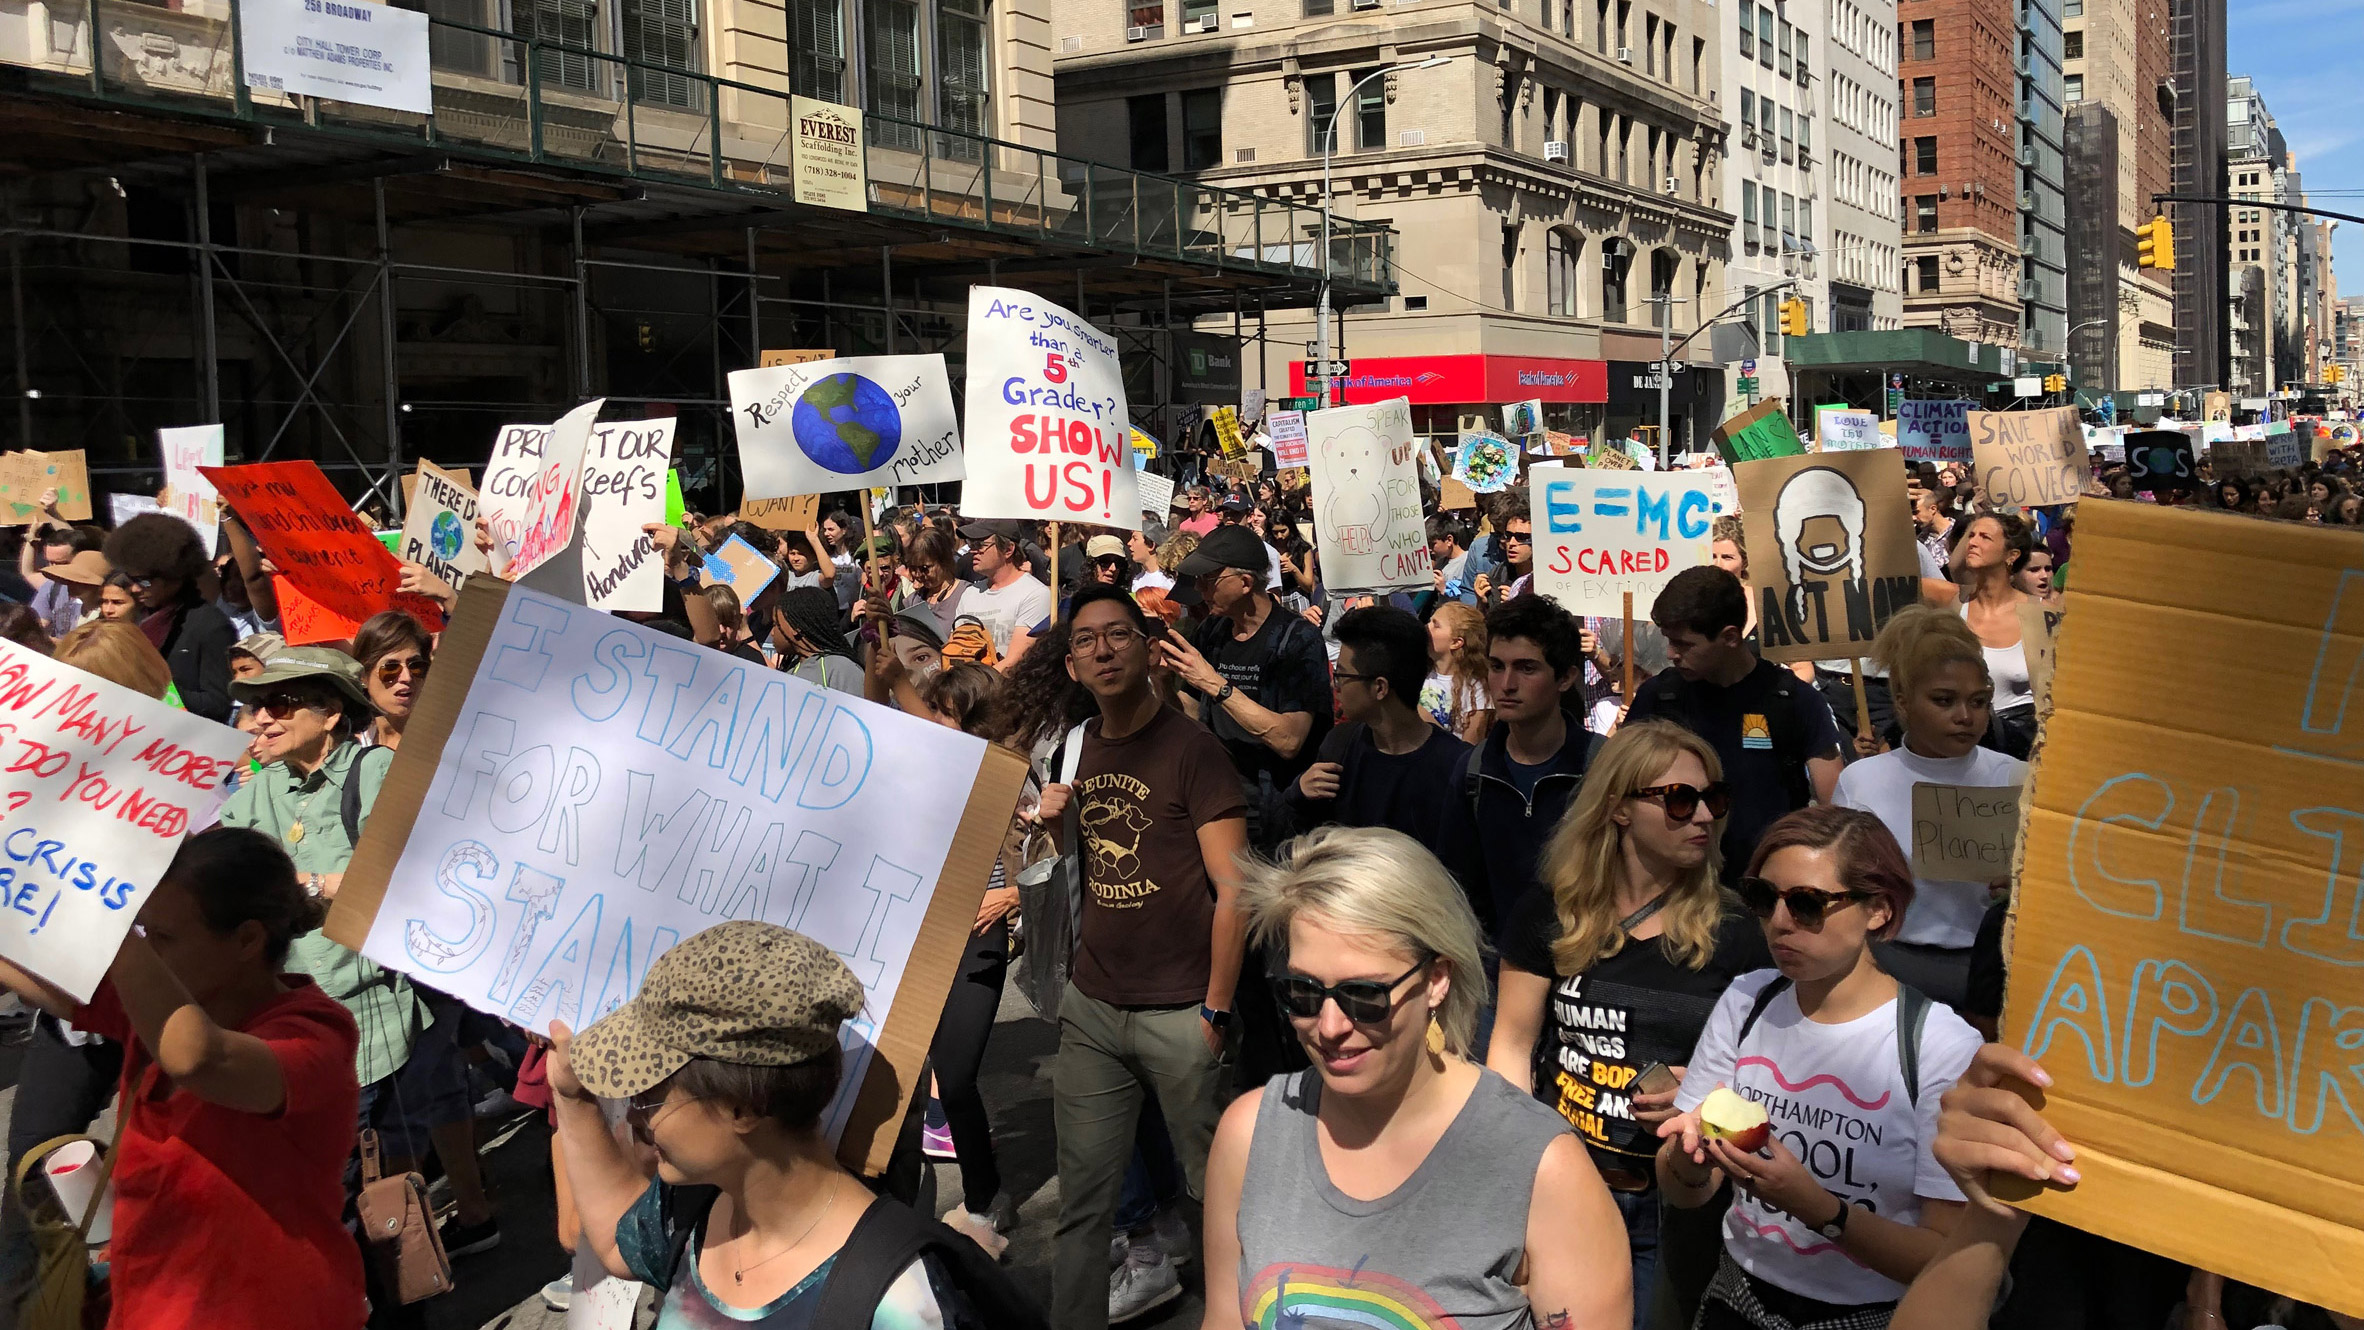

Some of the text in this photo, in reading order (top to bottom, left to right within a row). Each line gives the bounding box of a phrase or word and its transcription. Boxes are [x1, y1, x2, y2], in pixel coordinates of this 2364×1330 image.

[305, 0, 372, 22] 258 BROADWAY
[296, 36, 313, 47] CITY
[316, 39, 334, 52] HALL
[336, 43, 360, 56] TOWER
[297, 47, 325, 61] MATTHEW
[327, 51, 347, 64] ADAMS
[348, 55, 382, 70] PROPERTIES
[800, 118, 857, 144] EVEREST
[801, 139, 843, 157] Scaffolding
[845, 147, 858, 157] Inc.
[804, 165, 857, 180] (718) 328-1004
[984, 299, 1035, 321] Are
[1040, 311, 1072, 332] you
[1029, 330, 1086, 363] than a
[1208, 354, 1232, 368] Bank
[893, 375, 922, 408] your
[1355, 377, 1367, 388] of
[1368, 375, 1412, 387] America
[1540, 370, 1565, 387] America
[1633, 376, 1644, 389] DE
[743, 367, 809, 429] Respect
[1002, 376, 1117, 427] Grader?
[1899, 402, 1978, 420] CLIMATE
[1272, 419, 1300, 428] CAPITALISM
[1367, 408, 1409, 431] SPEAK
[1907, 419, 1971, 435] ACTION
[1979, 408, 2083, 445] SAVE THE
[617, 428, 669, 461] OUR
[1010, 413, 1124, 468] SHOW
[1391, 441, 1412, 467] UP
[1900, 445, 1937, 459] HUMAN
[2005, 440, 2076, 467] WORLD
[2269, 445, 2295, 456] WITH
[887, 431, 956, 483] mother
[1603, 448, 1632, 466] PLANET
[1604, 458, 1624, 469] OVER
[422, 471, 477, 522] THERE IS
[583, 464, 657, 506] Reefs
[1024, 460, 1113, 519] US!
[1387, 476, 1418, 500] FOR
[1985, 465, 2026, 507] GO
[1390, 504, 1420, 523] THOSE
[1341, 527, 1372, 554] HELP!
[1387, 531, 1421, 550] WHO
[406, 537, 464, 590] PLANET
[1548, 545, 1671, 575] SCARED
[1556, 581, 1572, 592] OF
[1763, 581, 1830, 648] ACT
[489, 596, 874, 811] I STAND
[32, 683, 146, 756] MANY
[132, 737, 235, 790] MORE
[5, 738, 189, 838] DO YOU NEED
[1920, 786, 2015, 819] There
[441, 711, 923, 990] FOR WHAT I
[1914, 819, 2014, 865] Planet
[4, 827, 136, 911] CRISIS
[1554, 999, 1627, 1033] HUMAN
[1558, 1046, 1591, 1079] ARE
[1555, 1071, 1597, 1111] FREE
